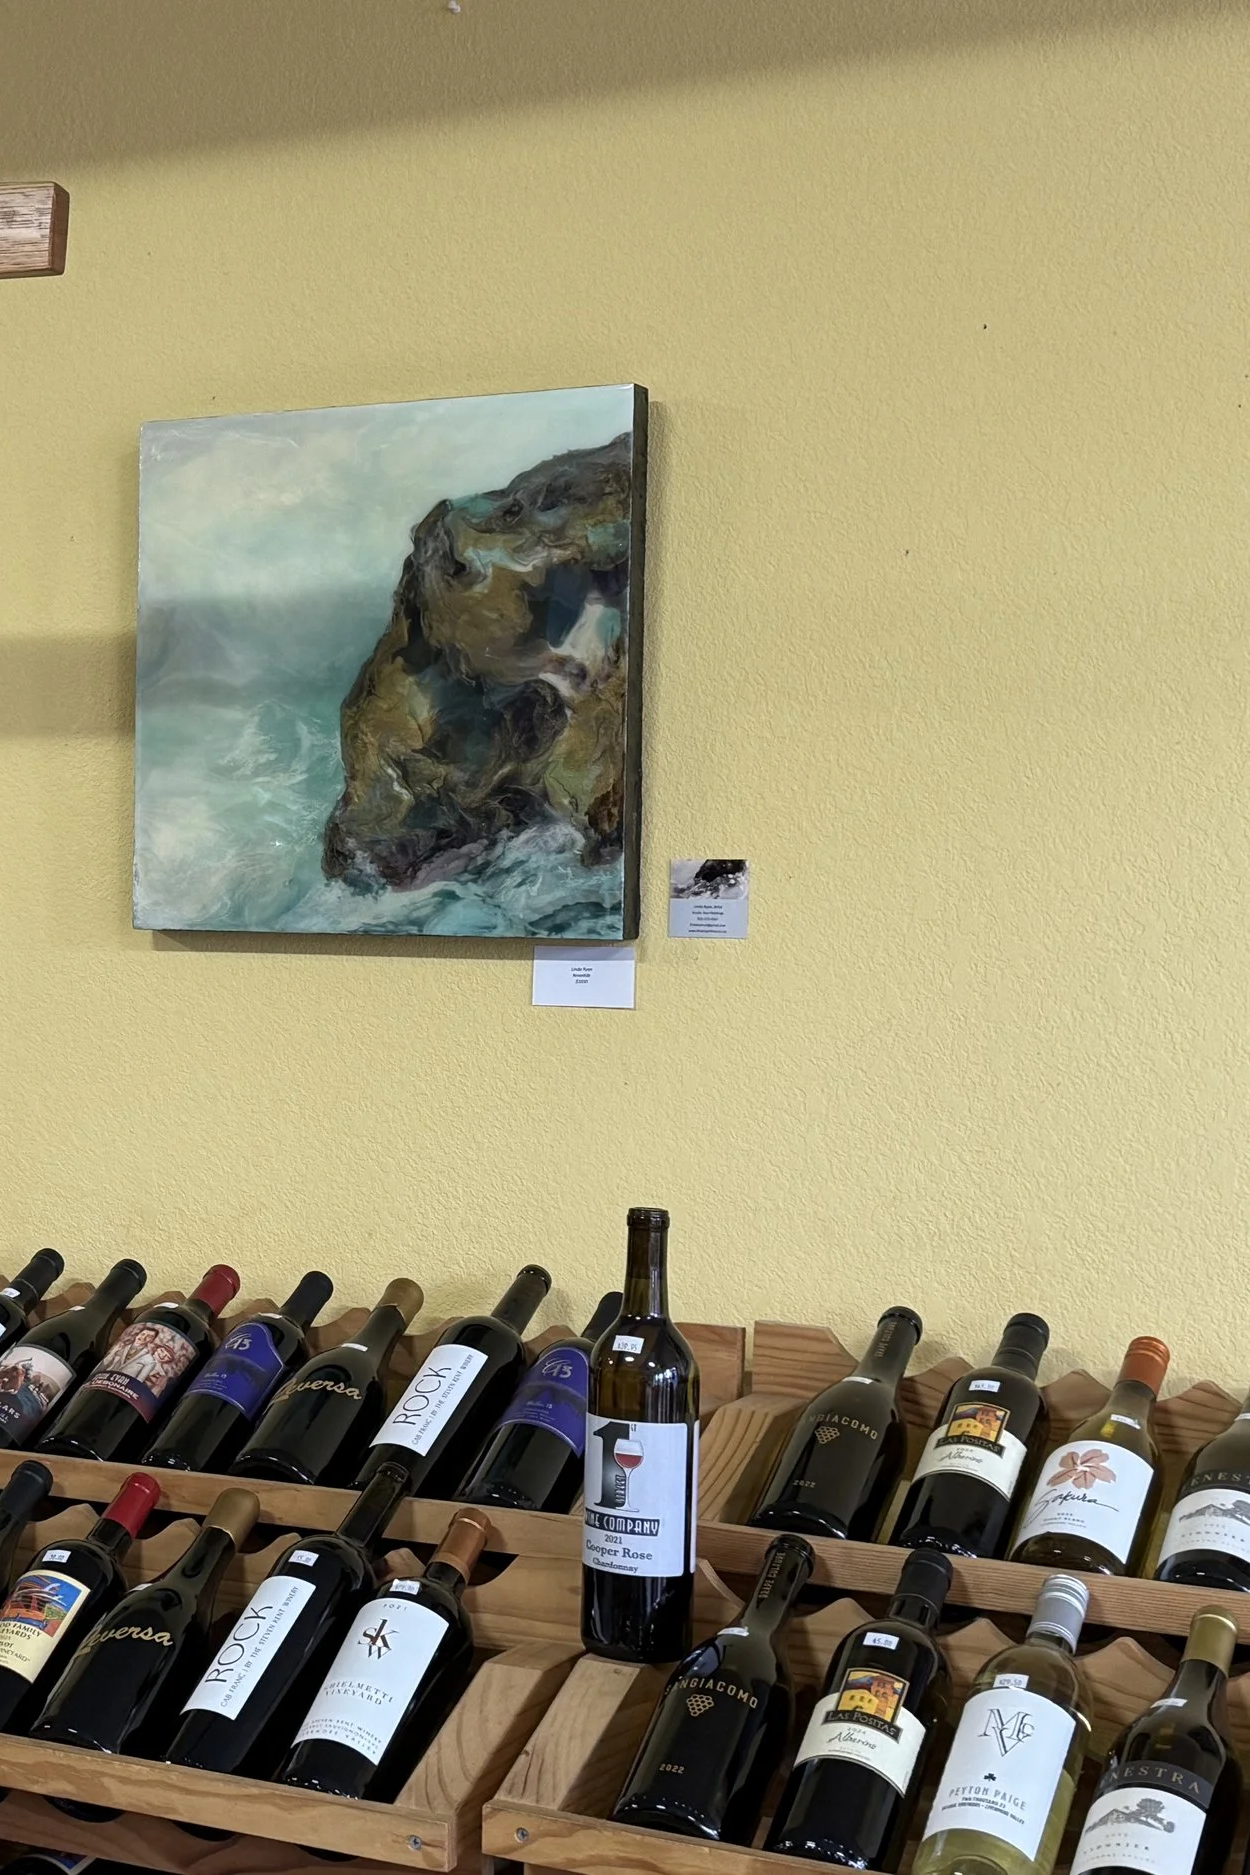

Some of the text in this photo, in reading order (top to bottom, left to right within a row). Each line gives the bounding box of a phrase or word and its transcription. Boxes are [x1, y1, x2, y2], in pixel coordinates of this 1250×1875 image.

[392, 1366, 453, 1426] ROCK
[805, 1412, 880, 1441] NGIACOMO
[1190, 1470, 1250, 1487] ENES
[603, 1516, 659, 1535] COMPANY
[585, 1538, 654, 1561] Cooper Rose
[604, 1533, 623, 1545] 2021
[591, 1556, 639, 1574] Chardonnay
[11, 1622, 42, 1638] FAMILY
[204, 1604, 274, 1684] ROCK
[220, 1692, 233, 1708] CAB
[228, 1671, 247, 1693] FRANC
[249, 1646, 263, 1661] THE
[257, 1623, 276, 1646] STEVEN
[273, 1607, 286, 1625] KENT
[281, 1585, 300, 1607] WINERY
[827, 1711, 897, 1736] LAS POSITAS
[658, 1762, 687, 1775] 2022
[1102, 1765, 1201, 1795] NESTRA
[948, 1785, 1027, 1812] PEYTON PAIGE
